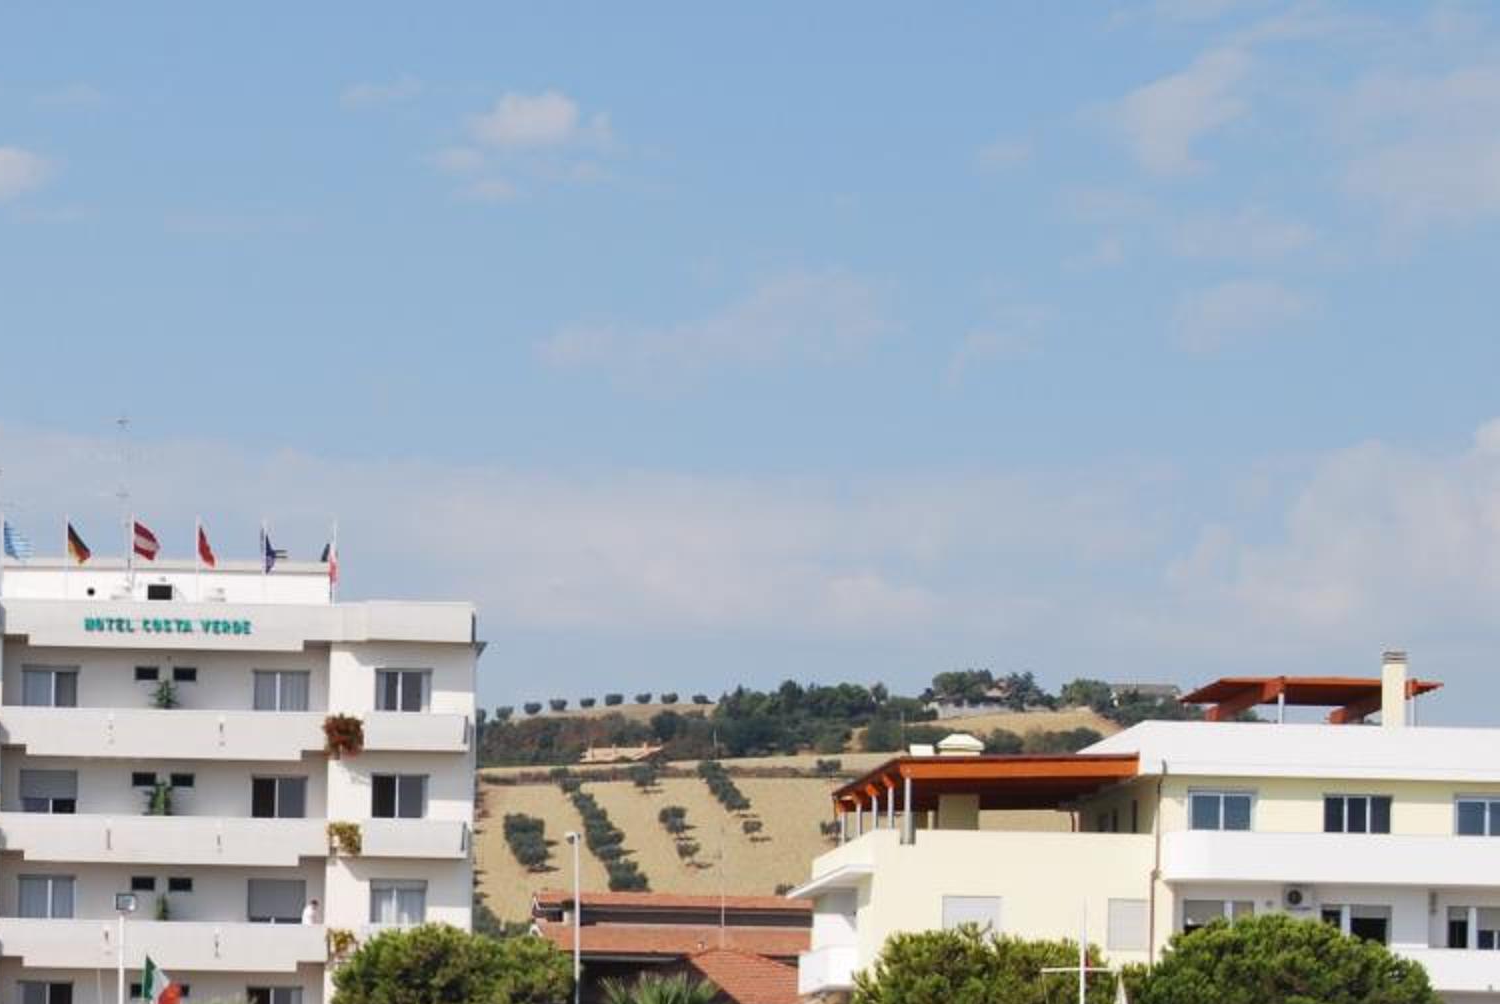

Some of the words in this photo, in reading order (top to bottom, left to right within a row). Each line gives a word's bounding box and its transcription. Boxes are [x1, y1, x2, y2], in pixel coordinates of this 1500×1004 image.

[84, 618, 134, 632] HOTEL
[143, 618, 192, 633] COSTA
[200, 620, 252, 635] VERDE
